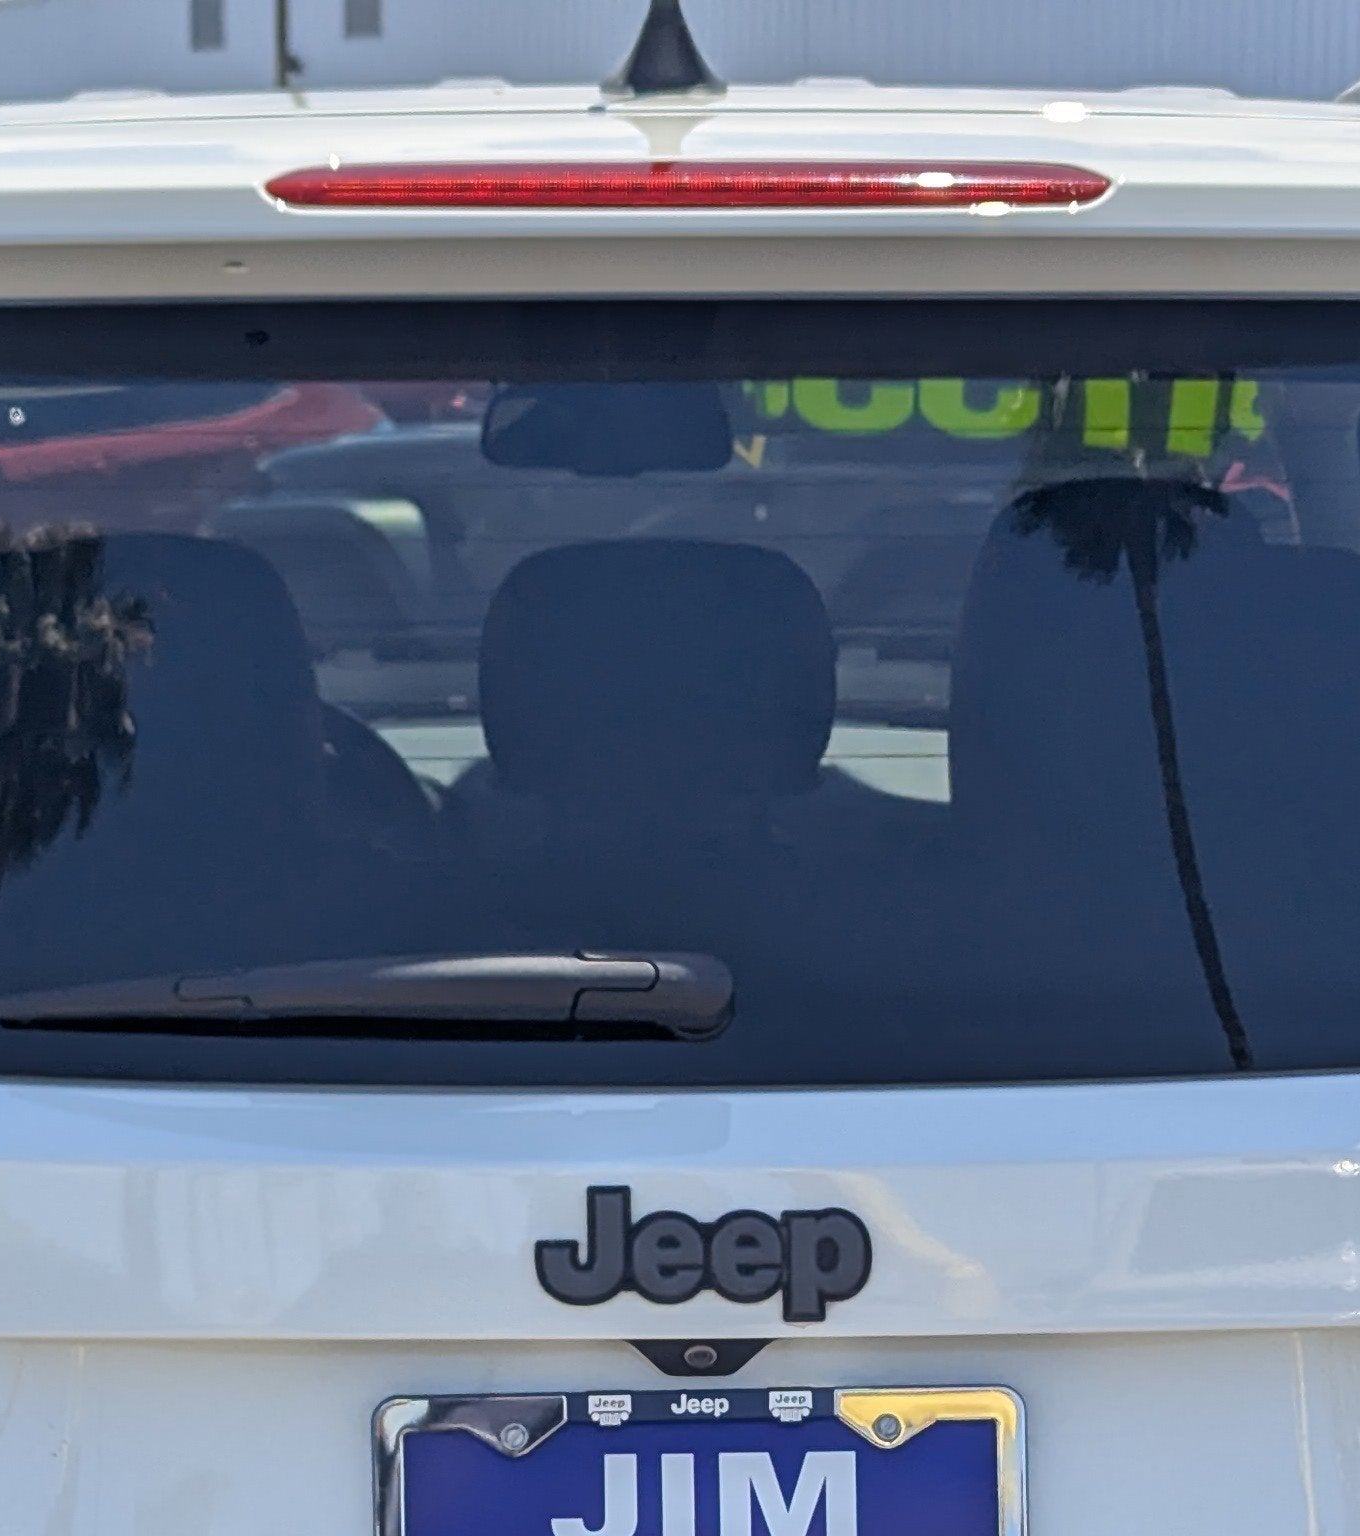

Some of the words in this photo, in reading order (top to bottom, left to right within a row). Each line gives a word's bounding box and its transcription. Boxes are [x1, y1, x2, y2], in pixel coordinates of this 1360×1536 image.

[534, 1185, 872, 1322] Jeep
[594, 1397, 626, 1409] Jeep
[670, 1393, 730, 1418] Jeep
[774, 1393, 807, 1406] Jeep
